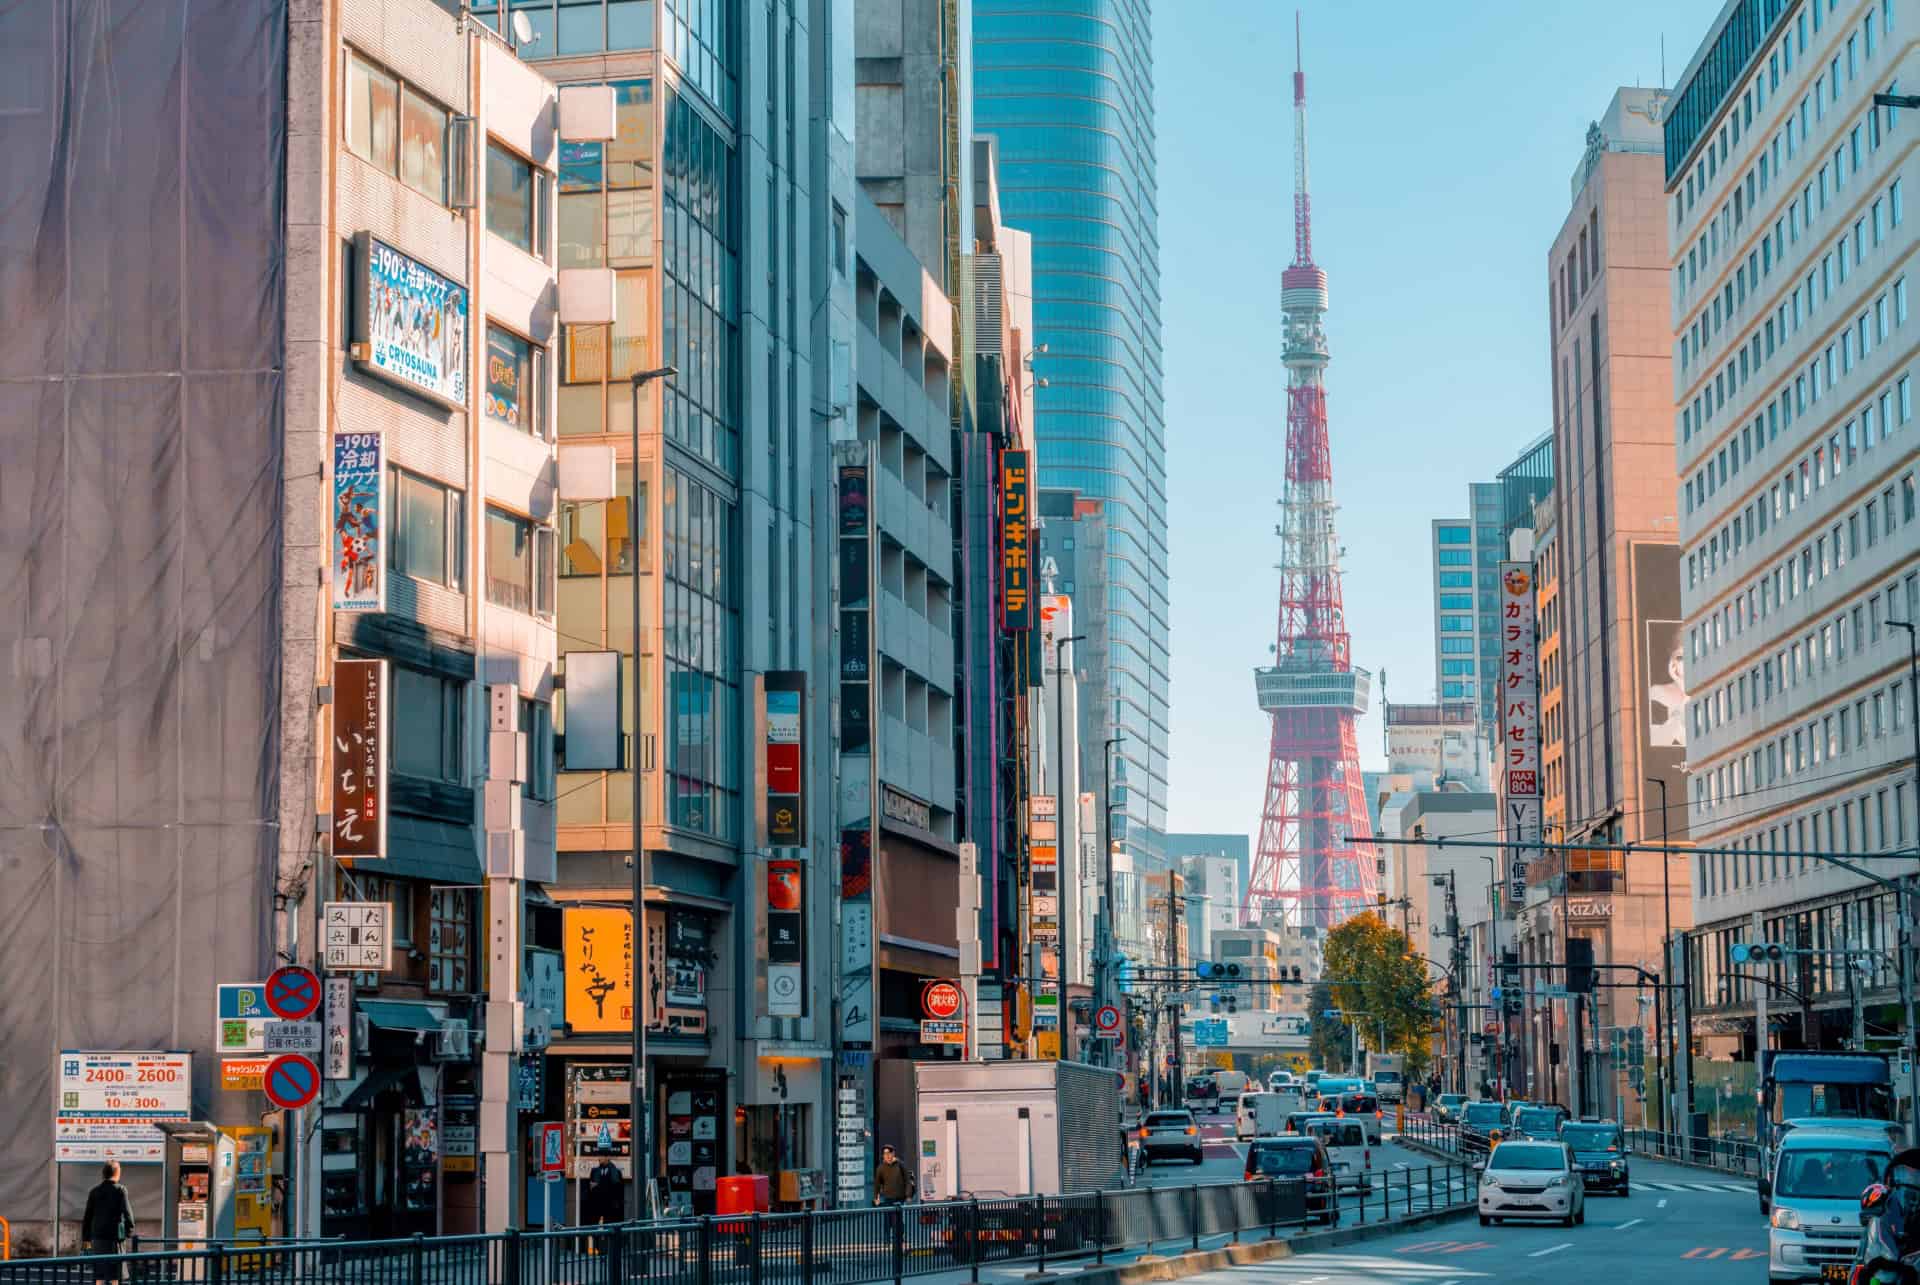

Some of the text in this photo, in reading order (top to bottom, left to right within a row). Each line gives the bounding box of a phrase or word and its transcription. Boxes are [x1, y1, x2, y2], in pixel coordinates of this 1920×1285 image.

[389, 344, 438, 379] CRYOSAUNA
[338, 450, 376, 469] 冷却
[335, 471, 380, 487] サウナ
[1505, 602, 1526, 765] カラオケ パセラ
[1511, 772, 1534, 781] MAX
[336, 732, 363, 842] いちえ
[930, 993, 957, 1008] 消火栓
